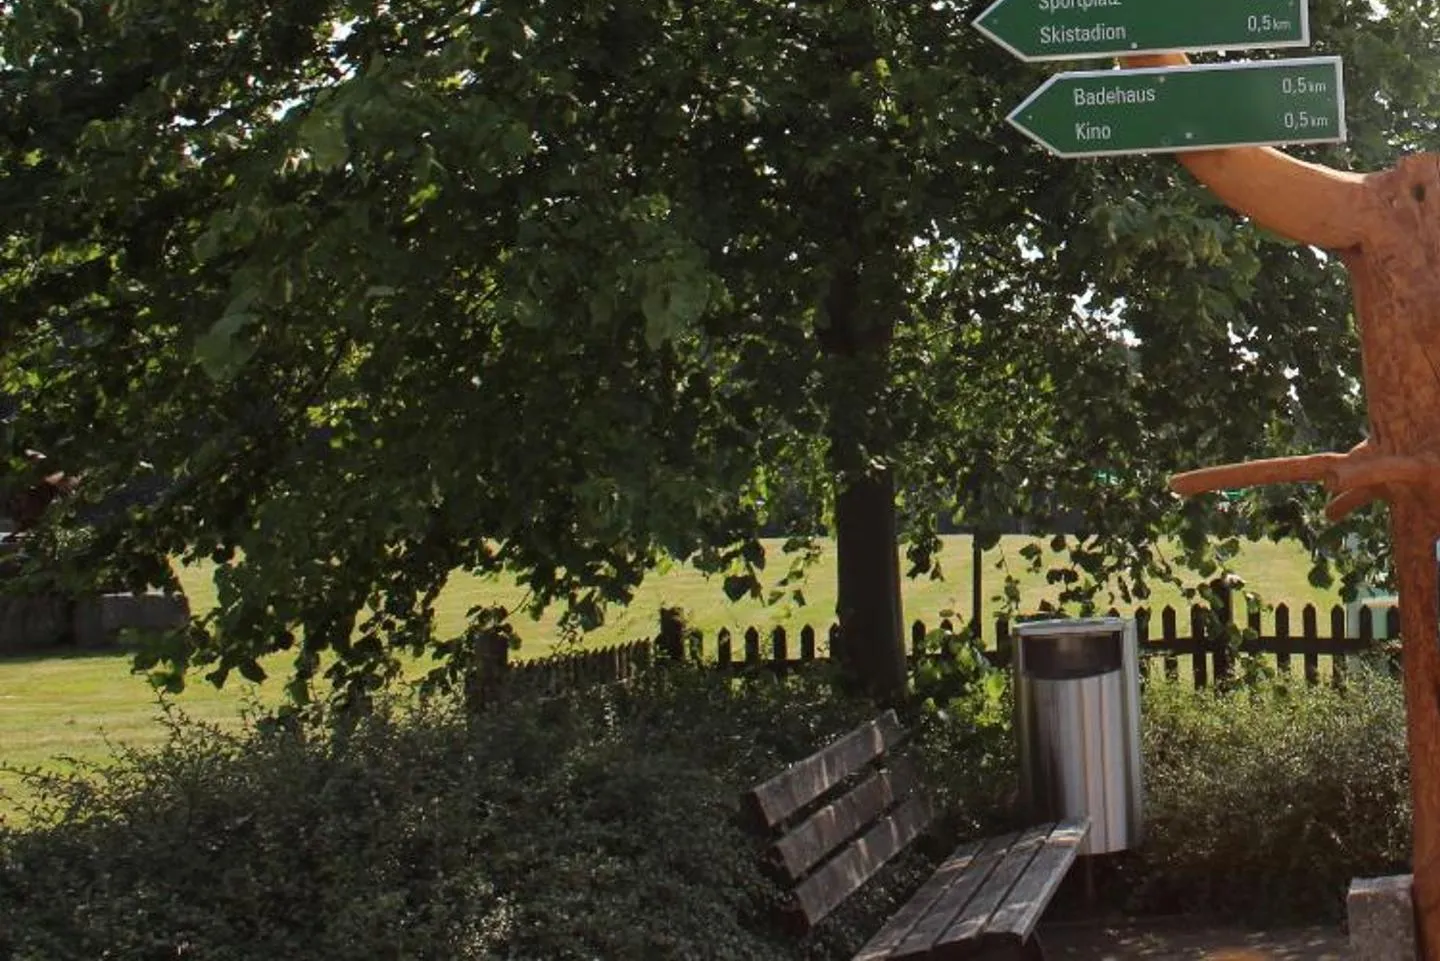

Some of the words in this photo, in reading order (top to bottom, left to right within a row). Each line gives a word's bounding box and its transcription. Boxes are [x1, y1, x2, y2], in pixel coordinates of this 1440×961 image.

[1039, 25, 1127, 44] Skistadion
[1074, 87, 1156, 106] Badehaus
[1075, 124, 1111, 141] Kino
